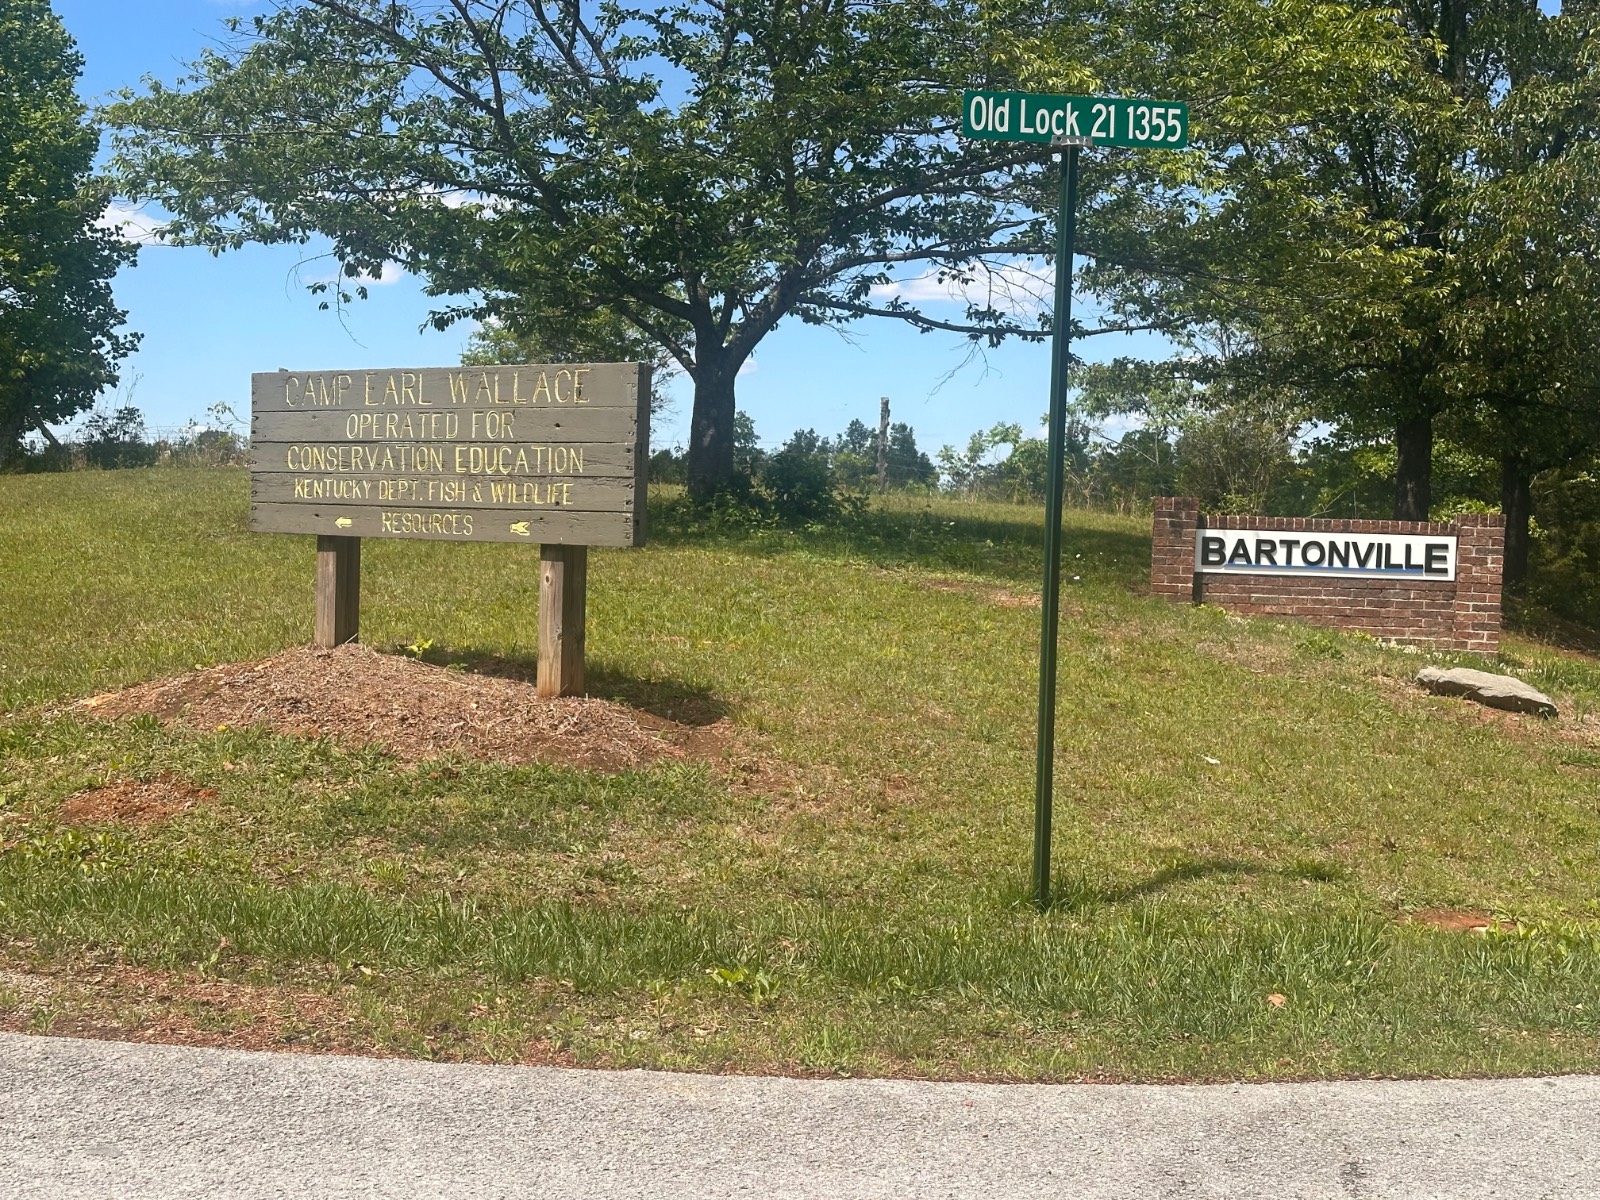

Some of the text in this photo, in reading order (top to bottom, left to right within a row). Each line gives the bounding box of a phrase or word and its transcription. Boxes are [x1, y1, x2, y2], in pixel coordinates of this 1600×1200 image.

[970, 96, 1181, 142] Old Lock 21 1355
[285, 369, 591, 406] CAMP EARL WALLACE
[346, 411, 514, 439] OPERATED FOR
[288, 446, 583, 475] CONSERVATION EDUCATION
[294, 479, 574, 505] KENTUCKY DEPT. FISH & WILDLIFE
[382, 513, 473, 536] RESOURCES
[1201, 536, 1449, 574] BARTONVILLE
